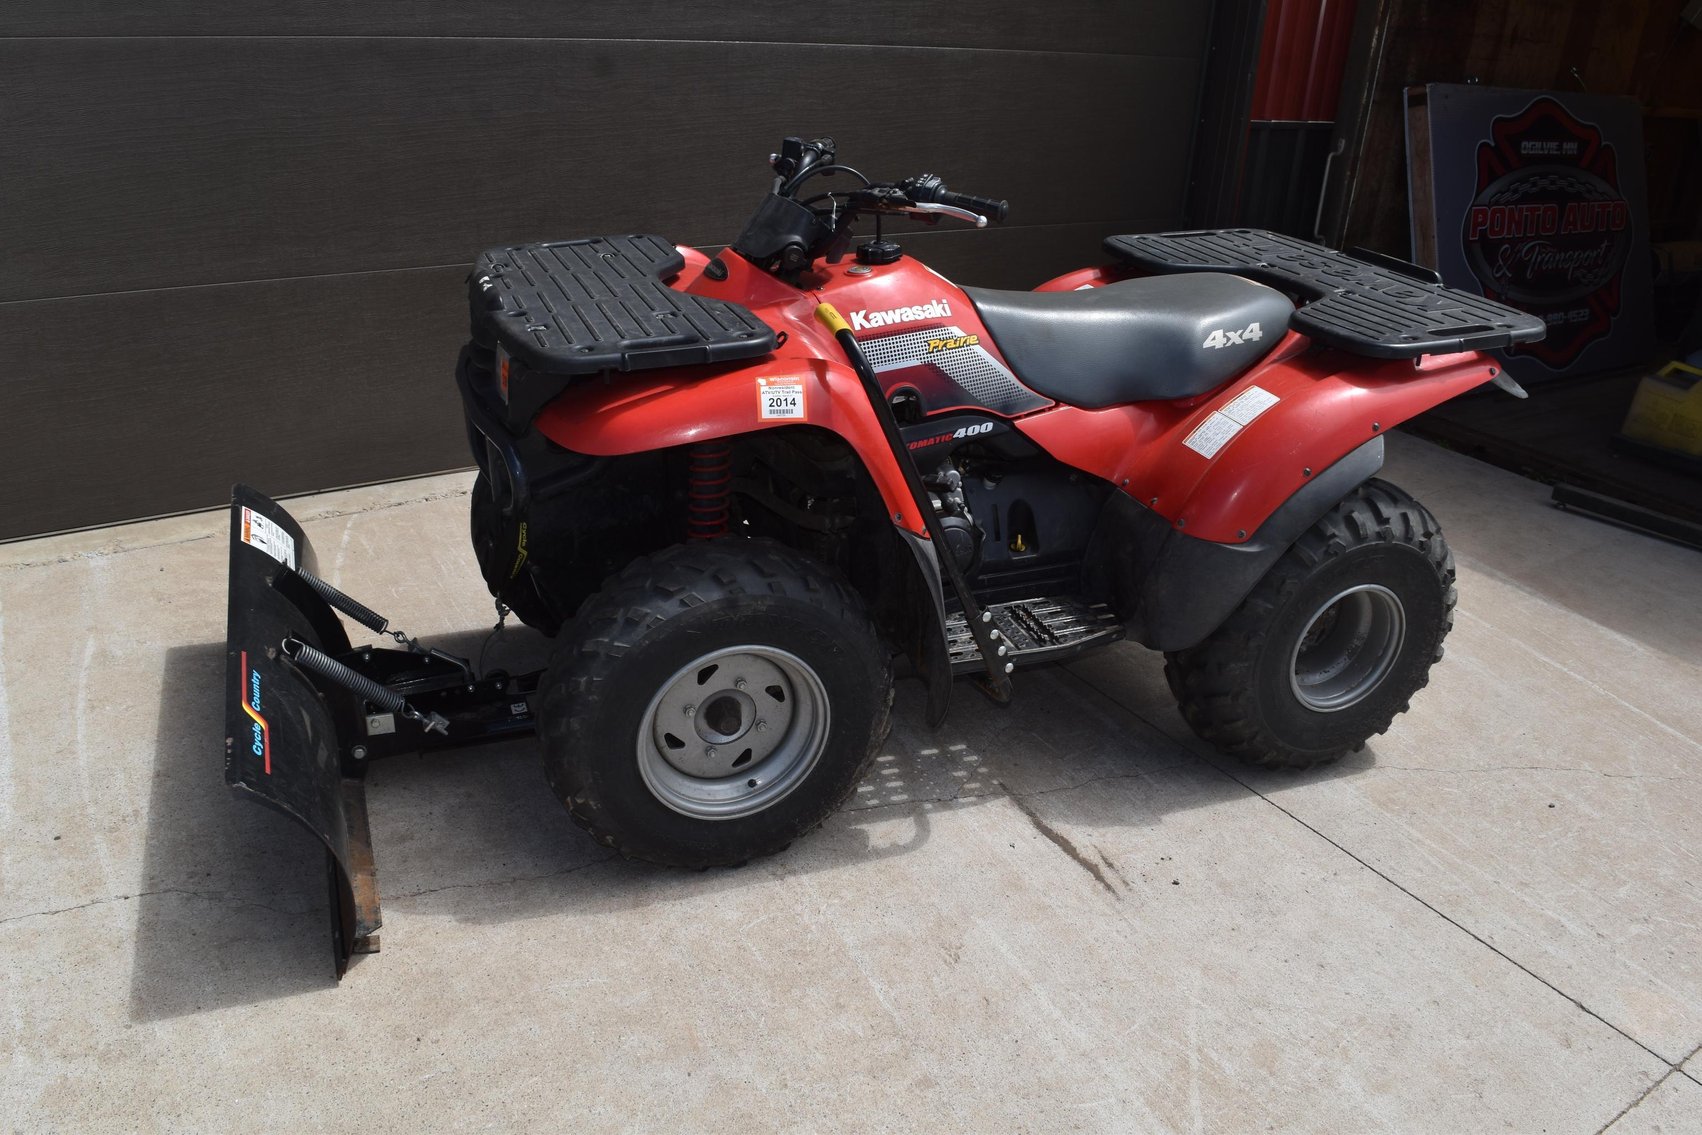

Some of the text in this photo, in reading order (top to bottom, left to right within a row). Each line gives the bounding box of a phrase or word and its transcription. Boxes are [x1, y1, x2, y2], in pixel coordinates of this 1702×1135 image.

[1469, 200, 1628, 240] PONTO AUTO
[1493, 240, 1608, 280] & Transport
[850, 298, 952, 331] Kawasaki
[928, 334, 979, 353] Prairie
[1202, 322, 1263, 350] 4x4
[768, 397, 797, 408] 2014
[906, 422, 994, 450] OMATIC 400
[251, 669, 263, 756] Cycle Country
